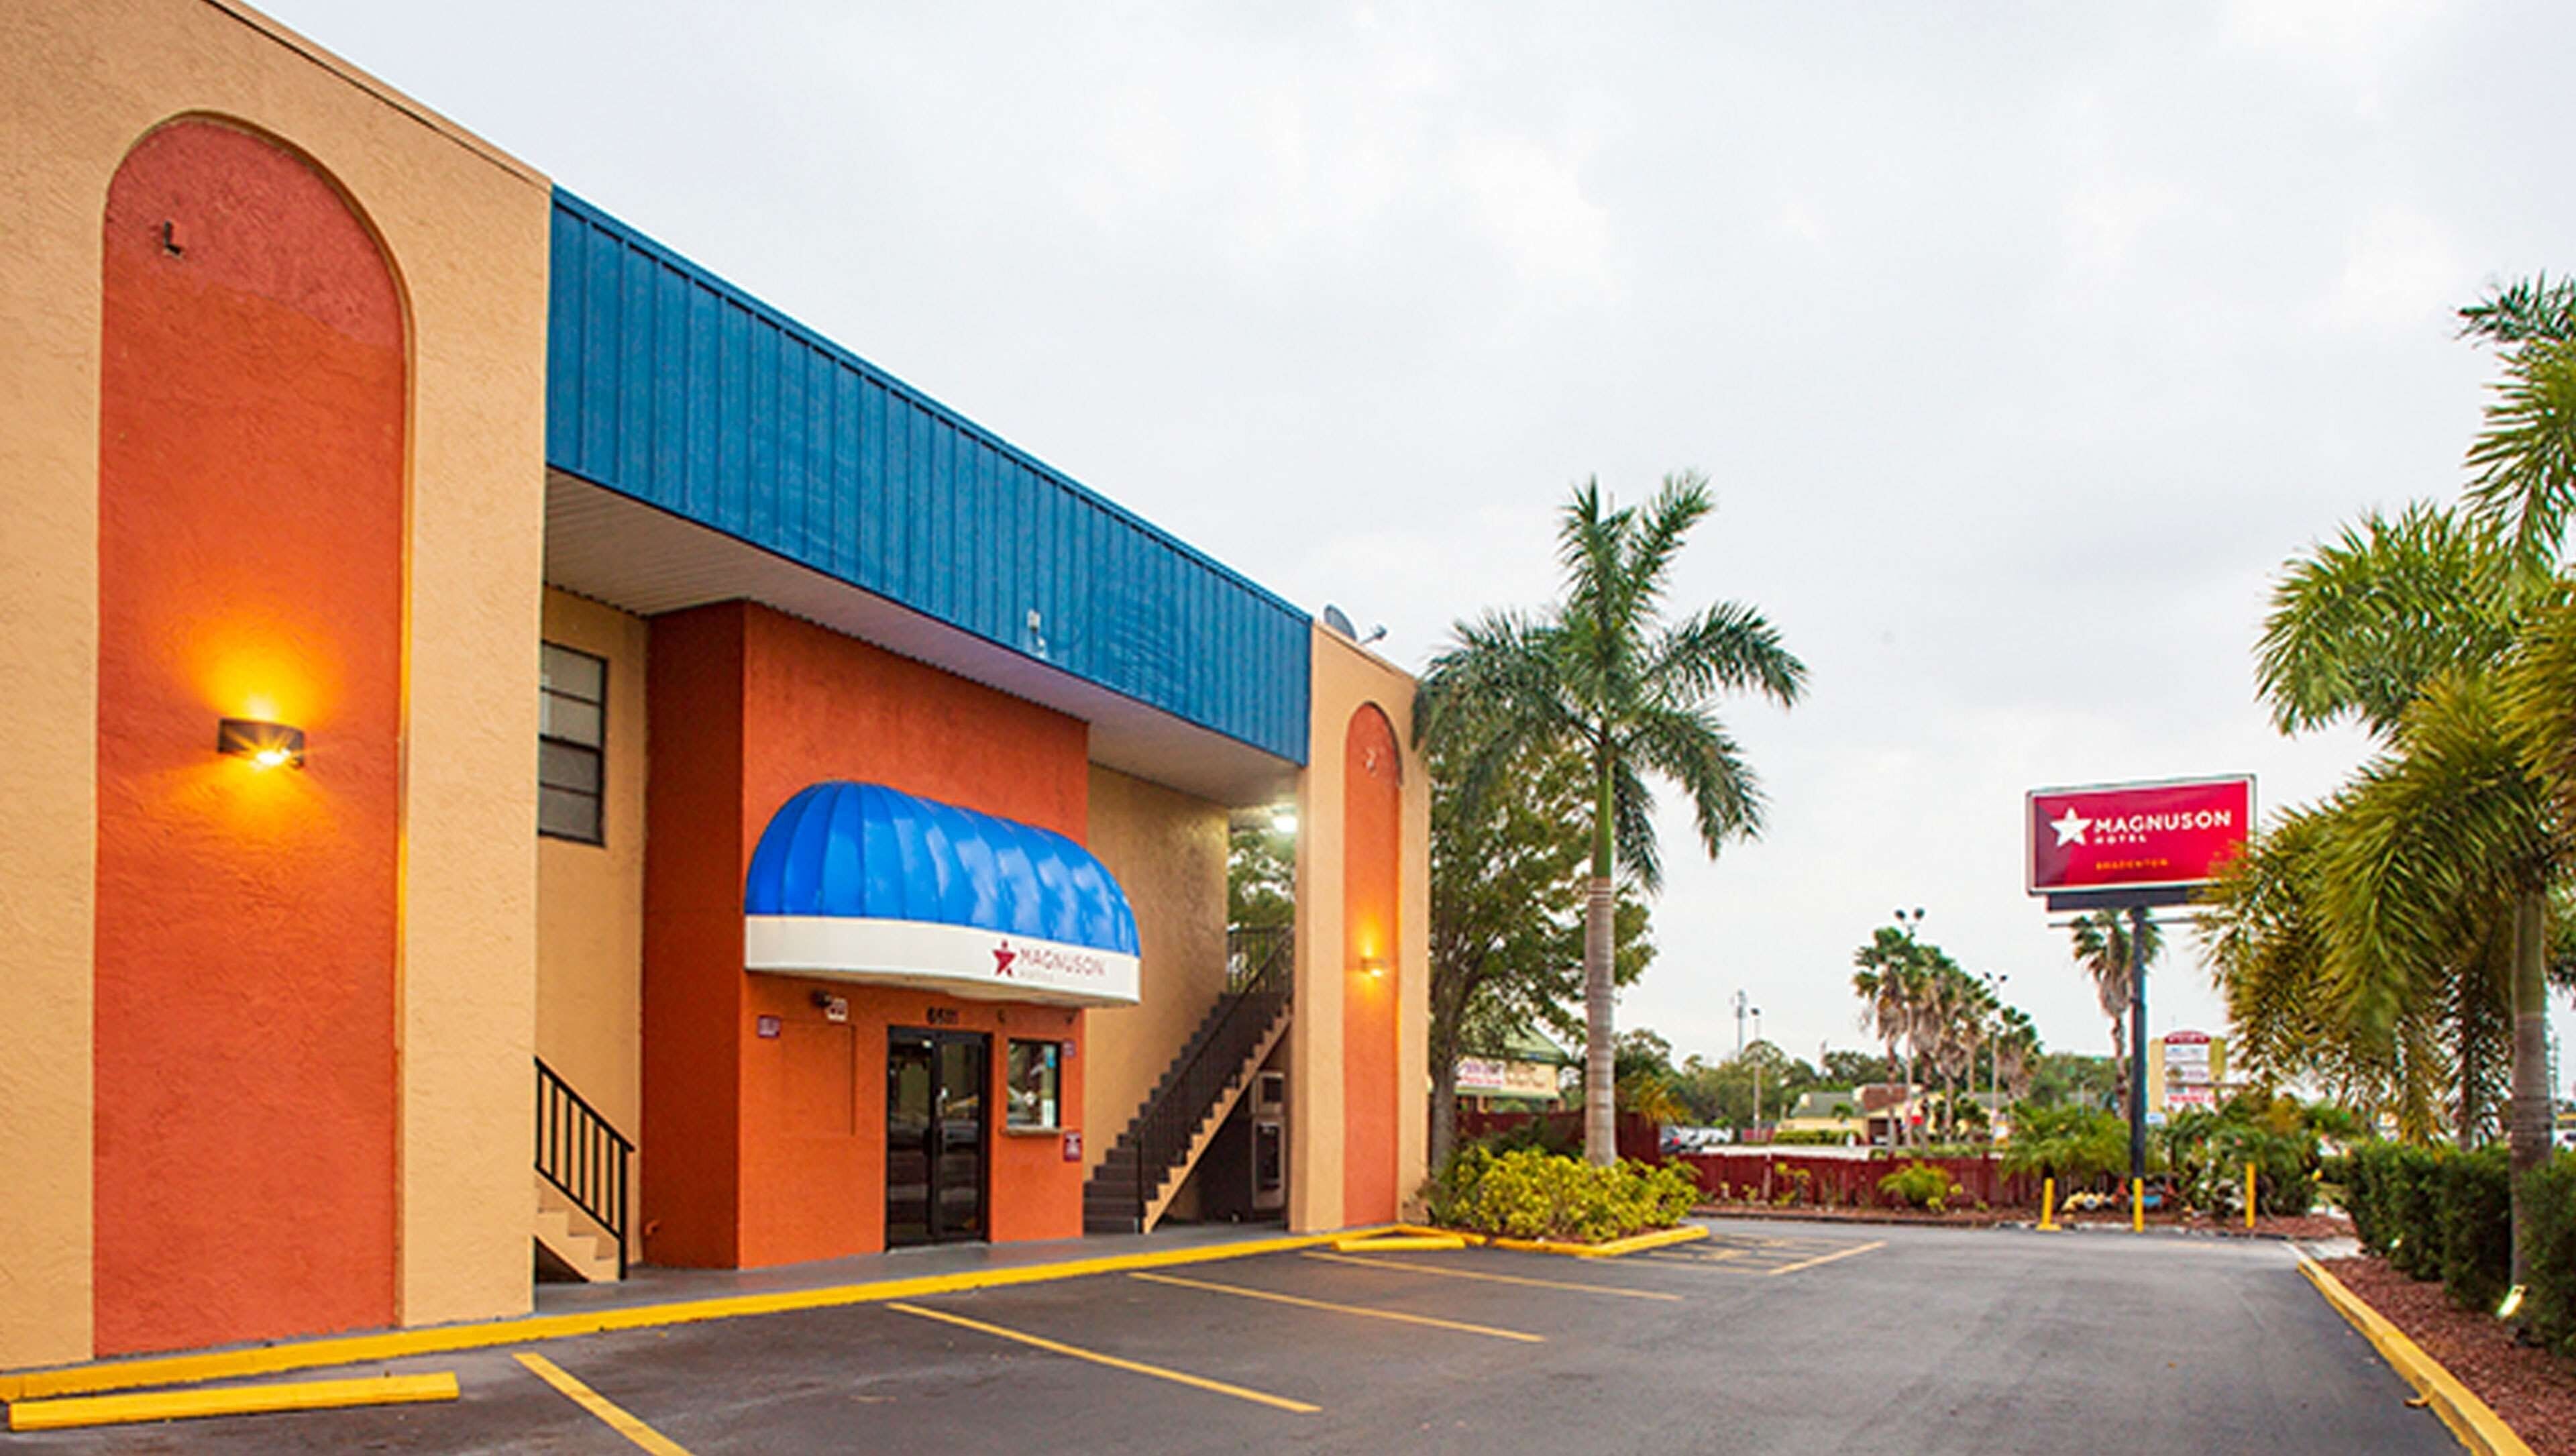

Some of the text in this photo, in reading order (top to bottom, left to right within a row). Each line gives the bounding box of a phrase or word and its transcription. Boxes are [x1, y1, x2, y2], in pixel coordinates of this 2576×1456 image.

[2094, 810, 2231, 833] MAGNUSON
[2094, 834, 2147, 845] HOTEL
[1019, 948, 1105, 976] MAGNUSON
